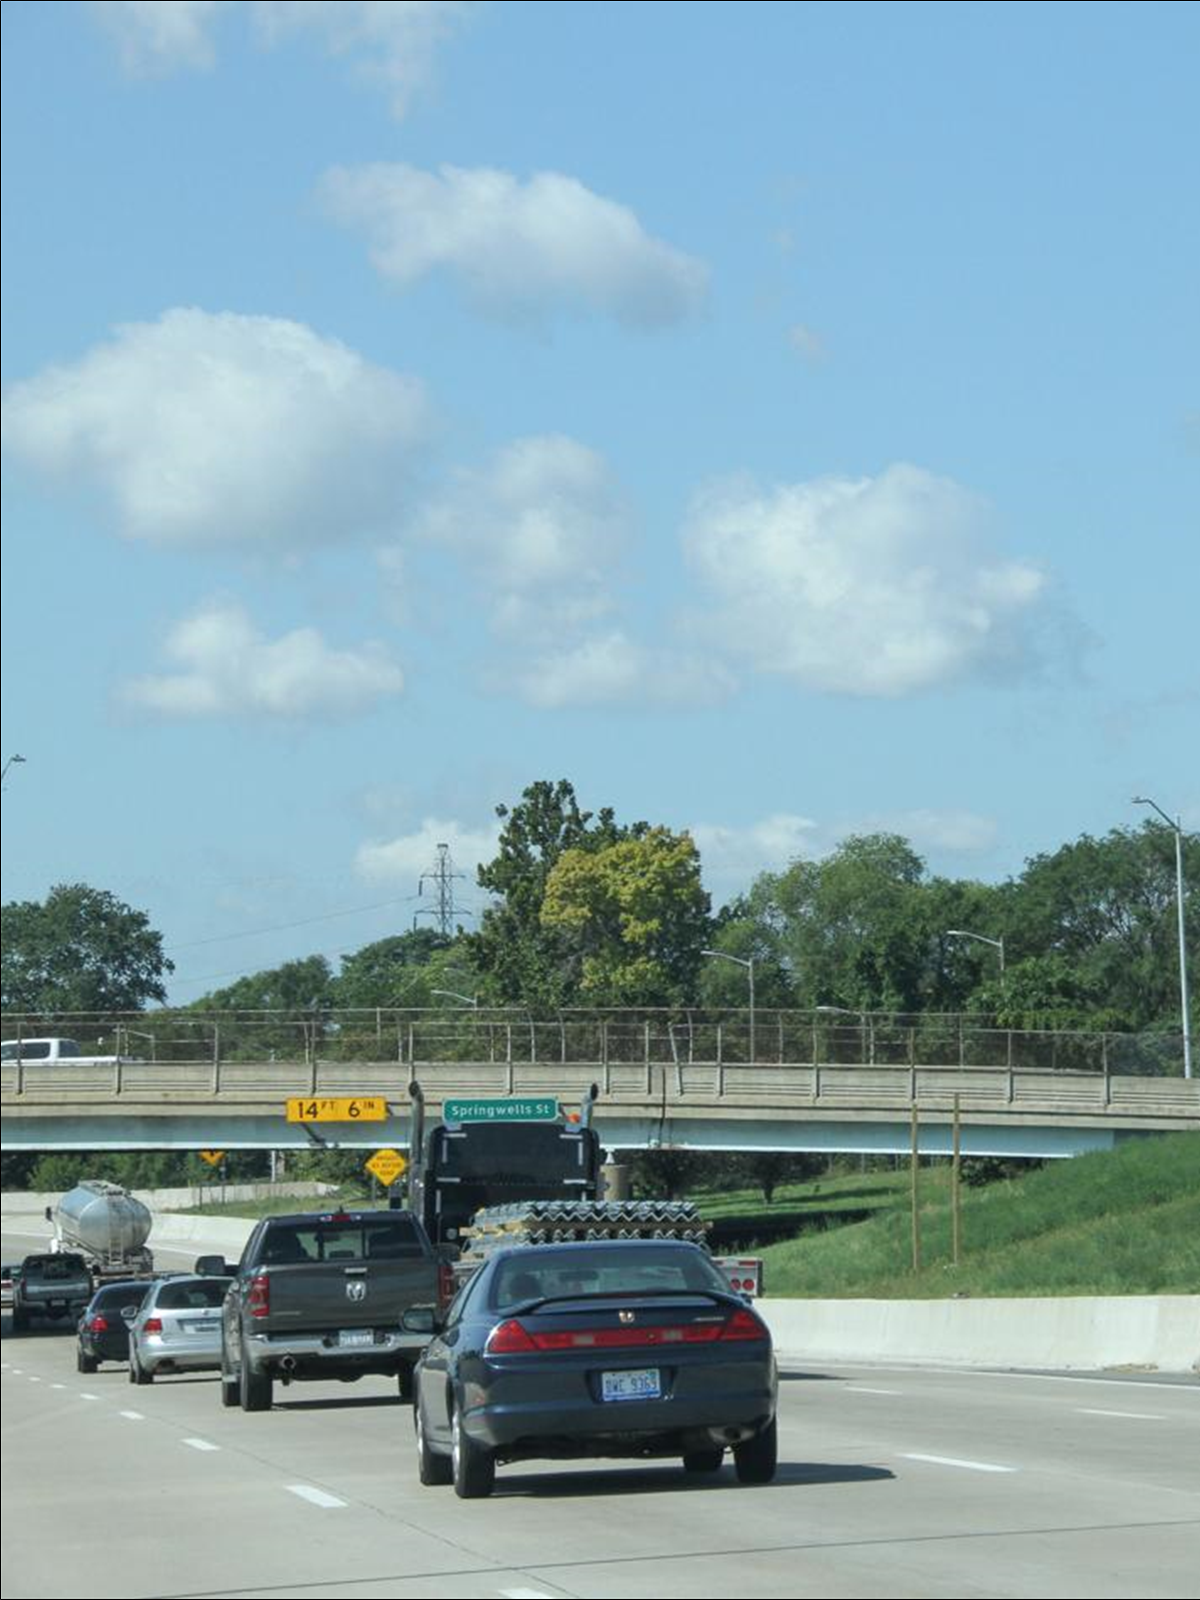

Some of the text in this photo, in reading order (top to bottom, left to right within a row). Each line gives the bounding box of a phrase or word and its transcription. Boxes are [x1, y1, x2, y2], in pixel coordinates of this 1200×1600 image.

[298, 1101, 318, 1119] 14
[348, 1101, 360, 1118] 6
[451, 1104, 549, 1118] Springwells St
